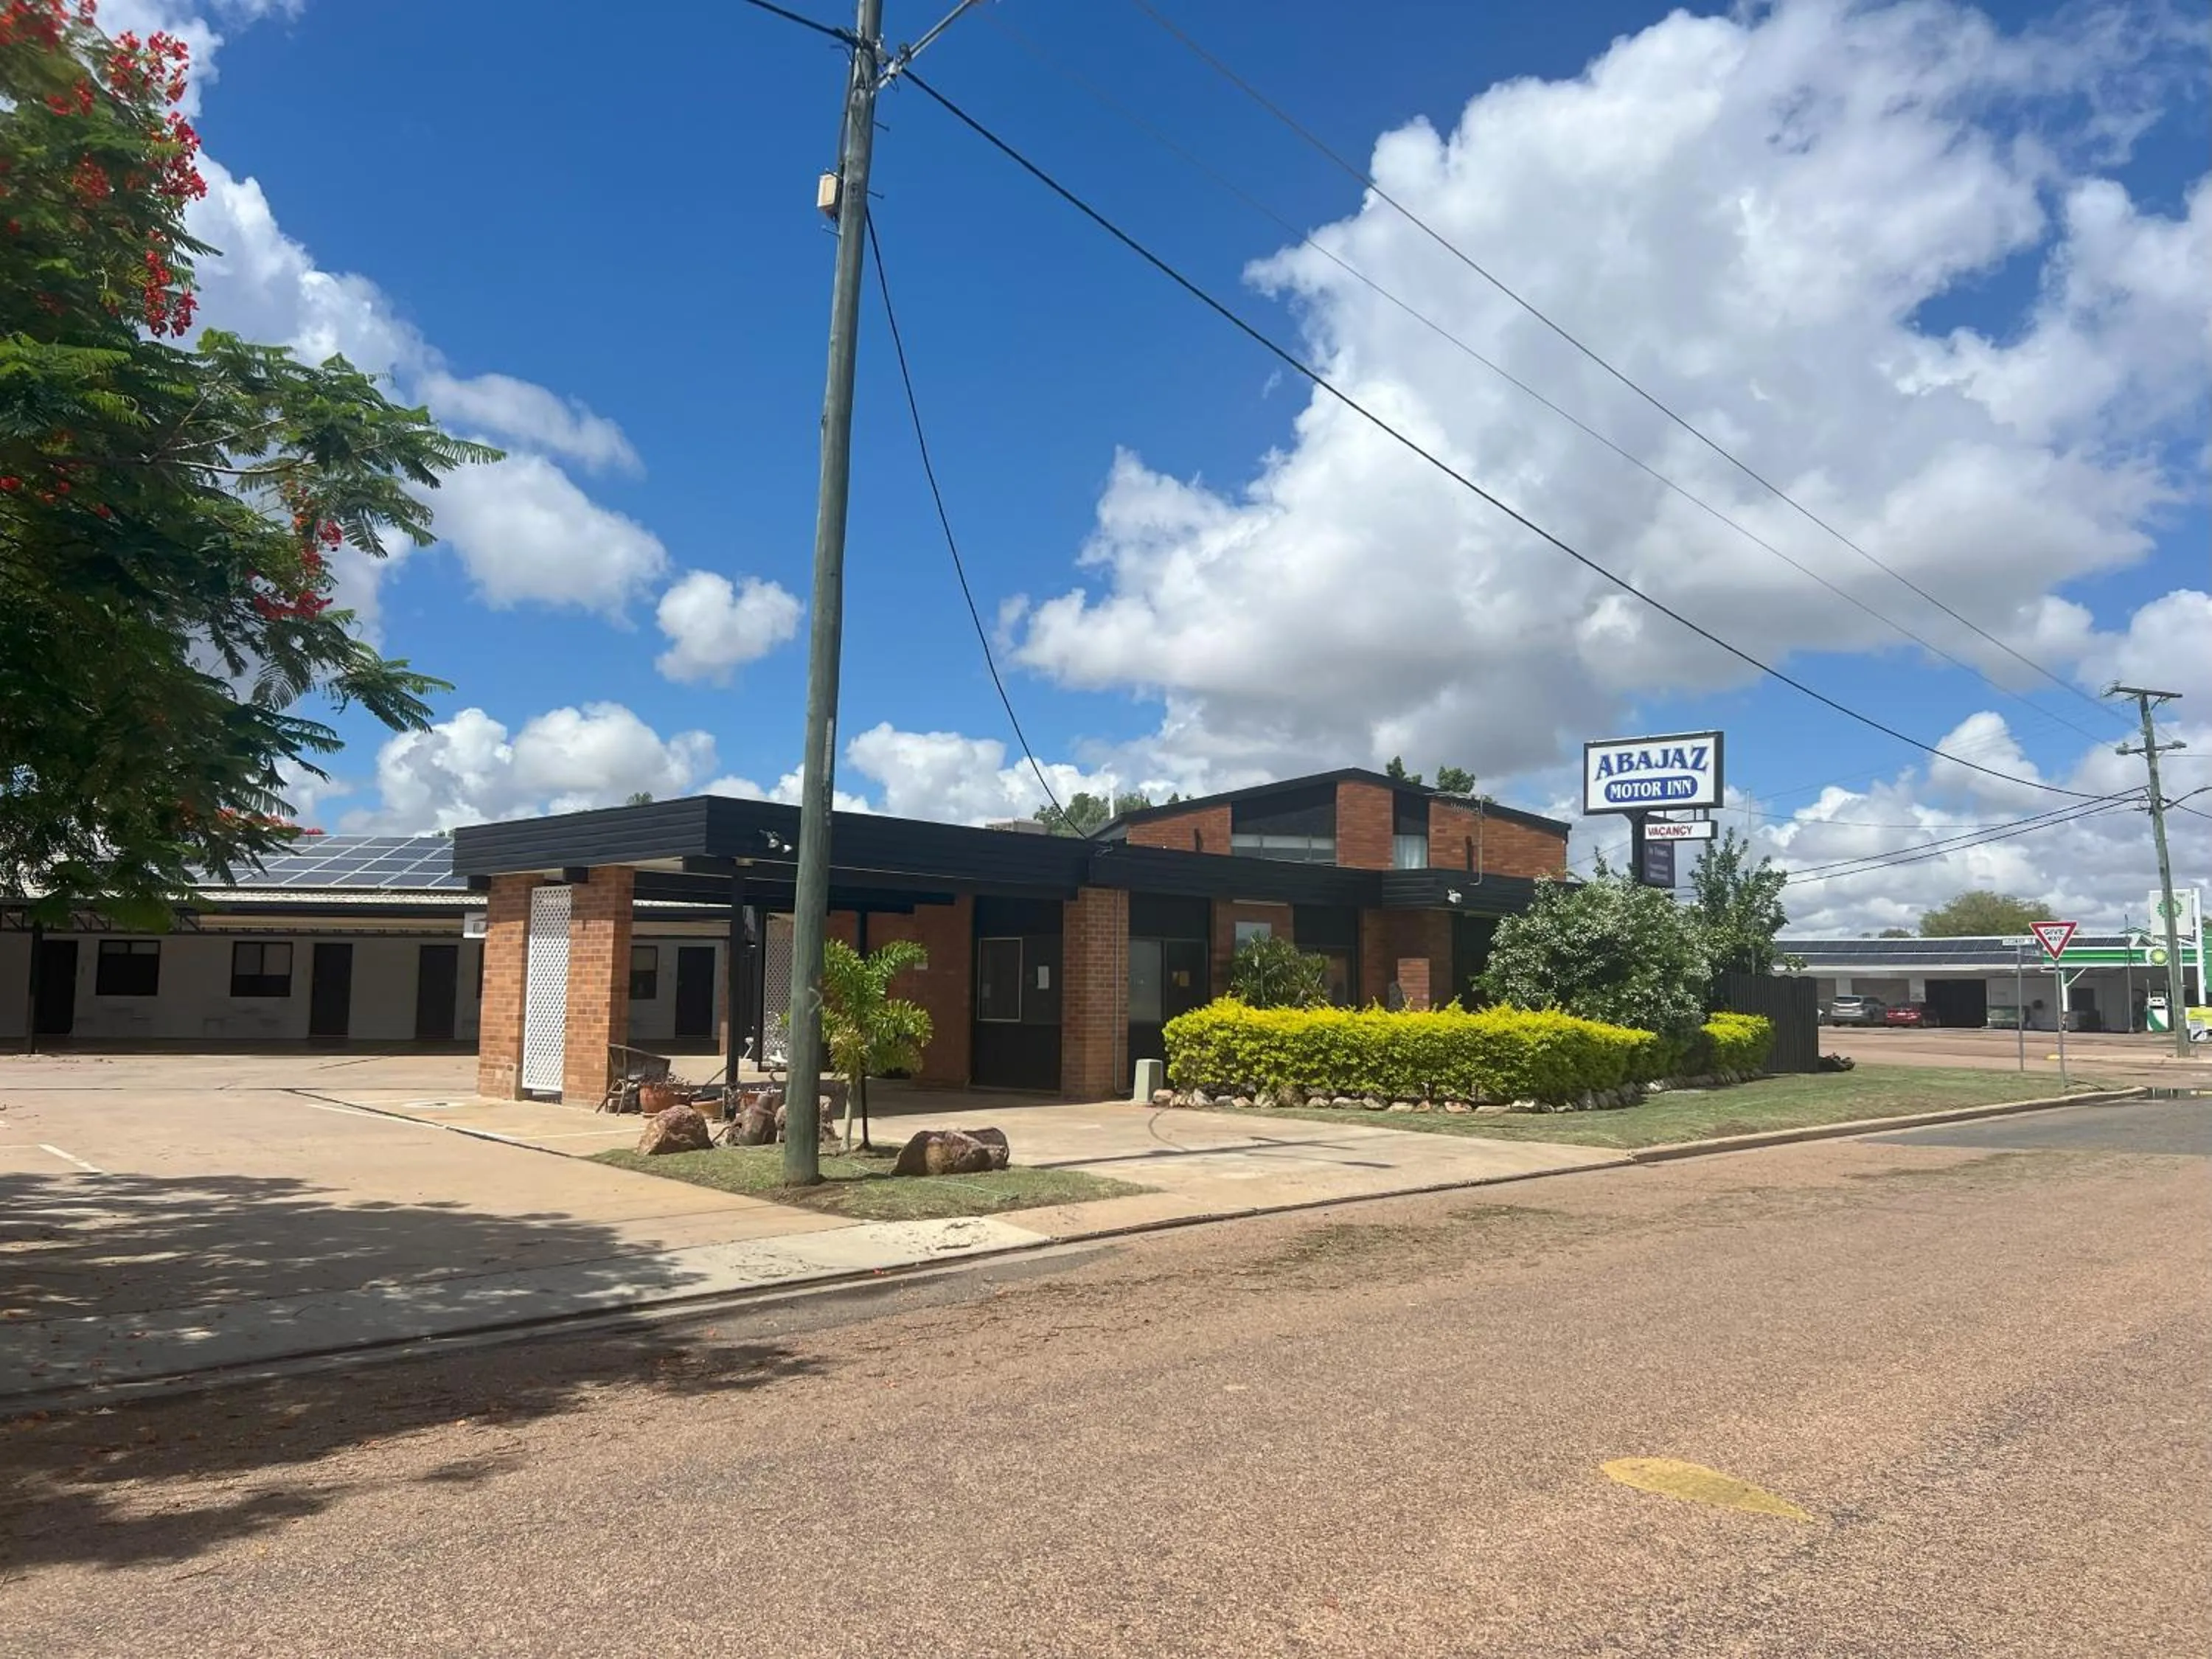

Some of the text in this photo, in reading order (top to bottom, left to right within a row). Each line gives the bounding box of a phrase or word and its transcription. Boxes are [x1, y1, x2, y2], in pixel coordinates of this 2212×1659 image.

[1595, 746, 1708, 781] ABAJAZ
[1610, 779, 1691, 799] MOTOR INN
[1647, 824, 1694, 836] VACANCY
